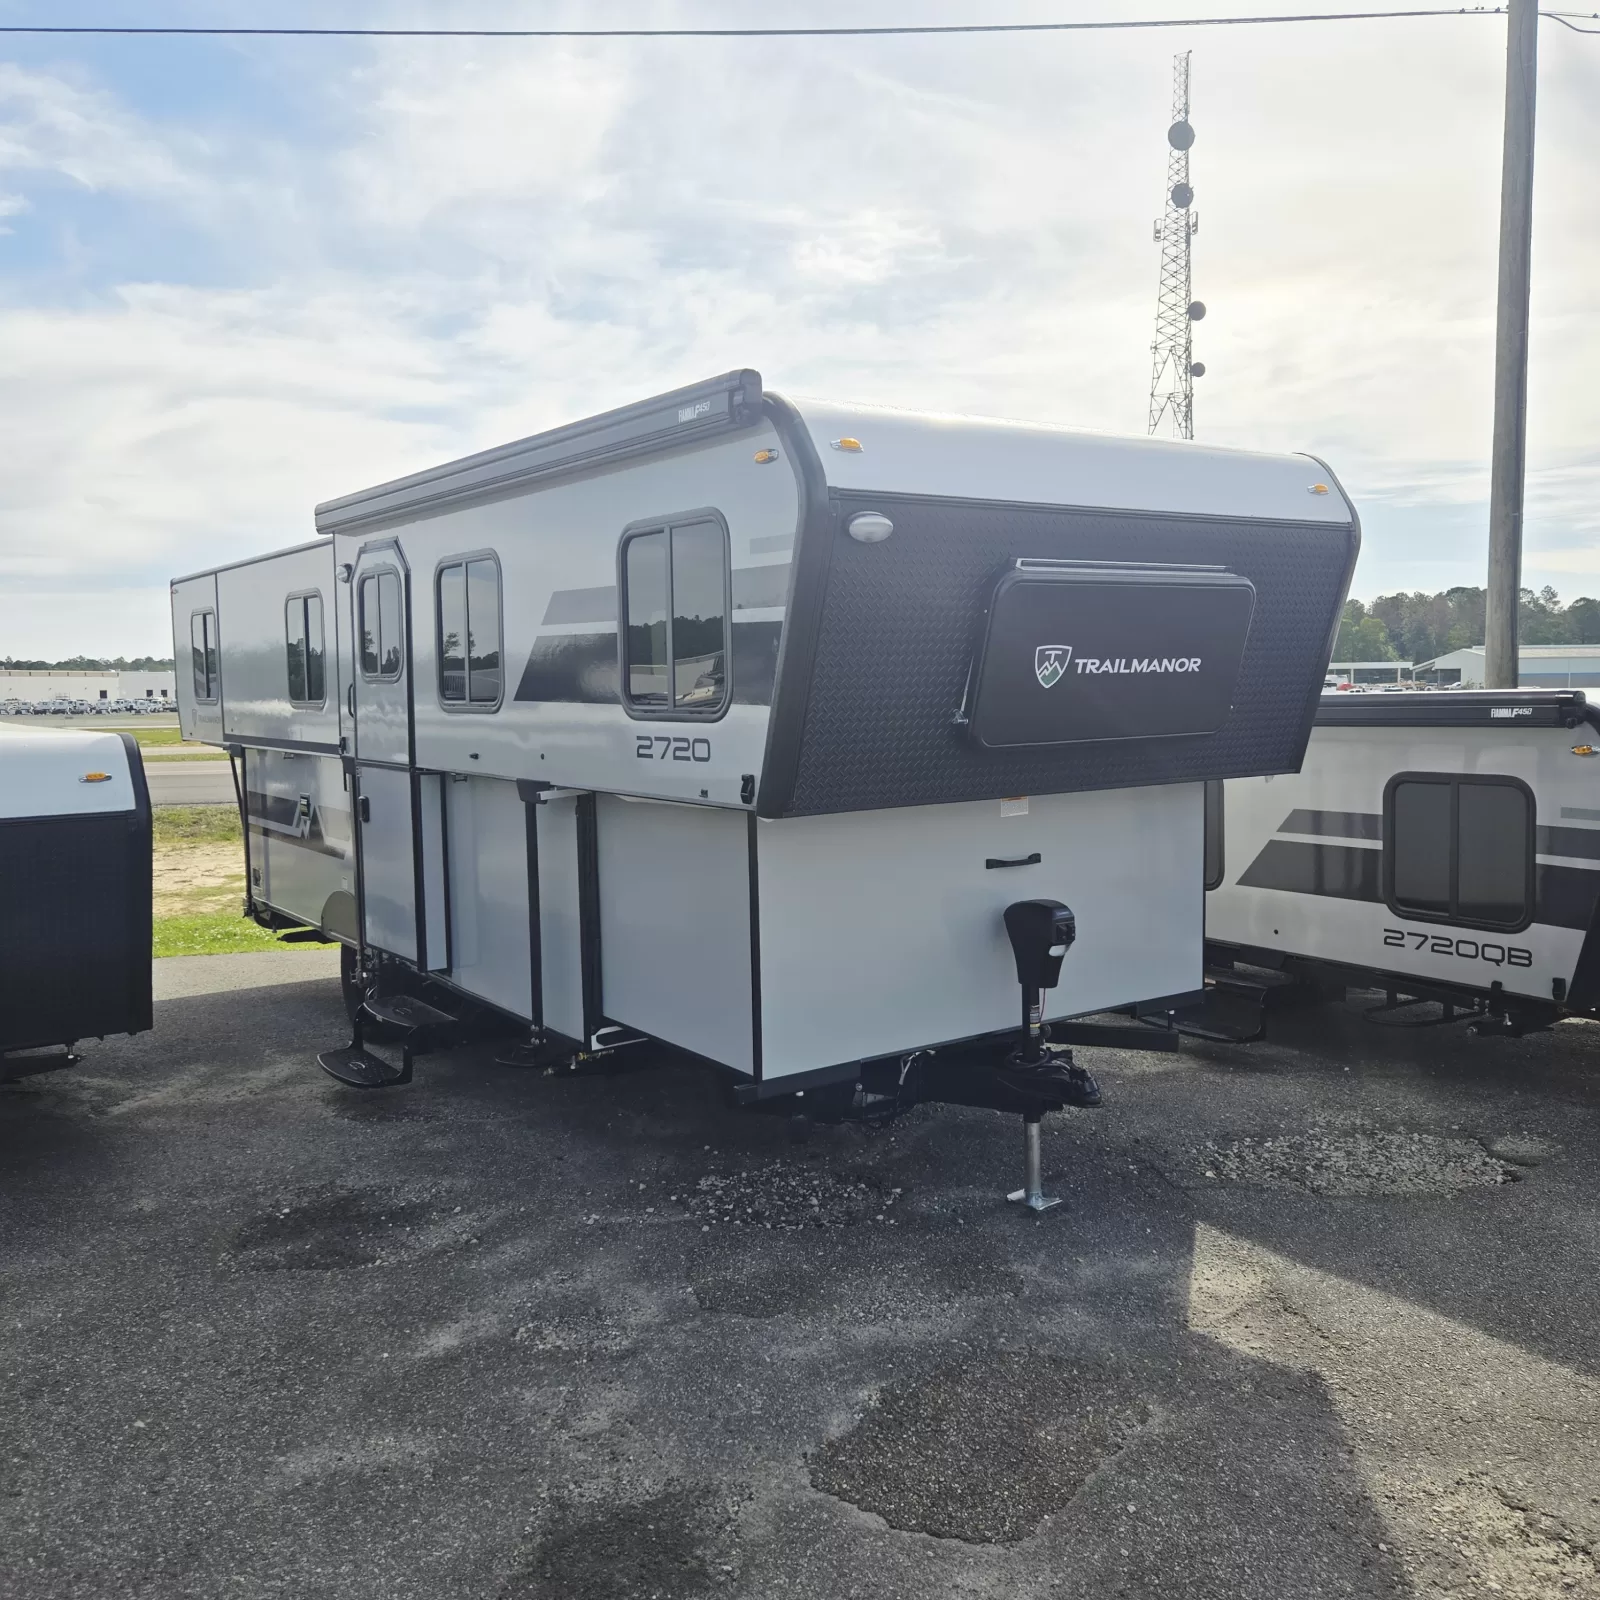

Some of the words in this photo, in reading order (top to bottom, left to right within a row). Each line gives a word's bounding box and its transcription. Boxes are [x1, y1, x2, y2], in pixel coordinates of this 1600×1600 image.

[1074, 658, 1201, 674] TRAILMANOR
[636, 735, 711, 763] 2720
[1383, 928, 1533, 968] 2720QB
